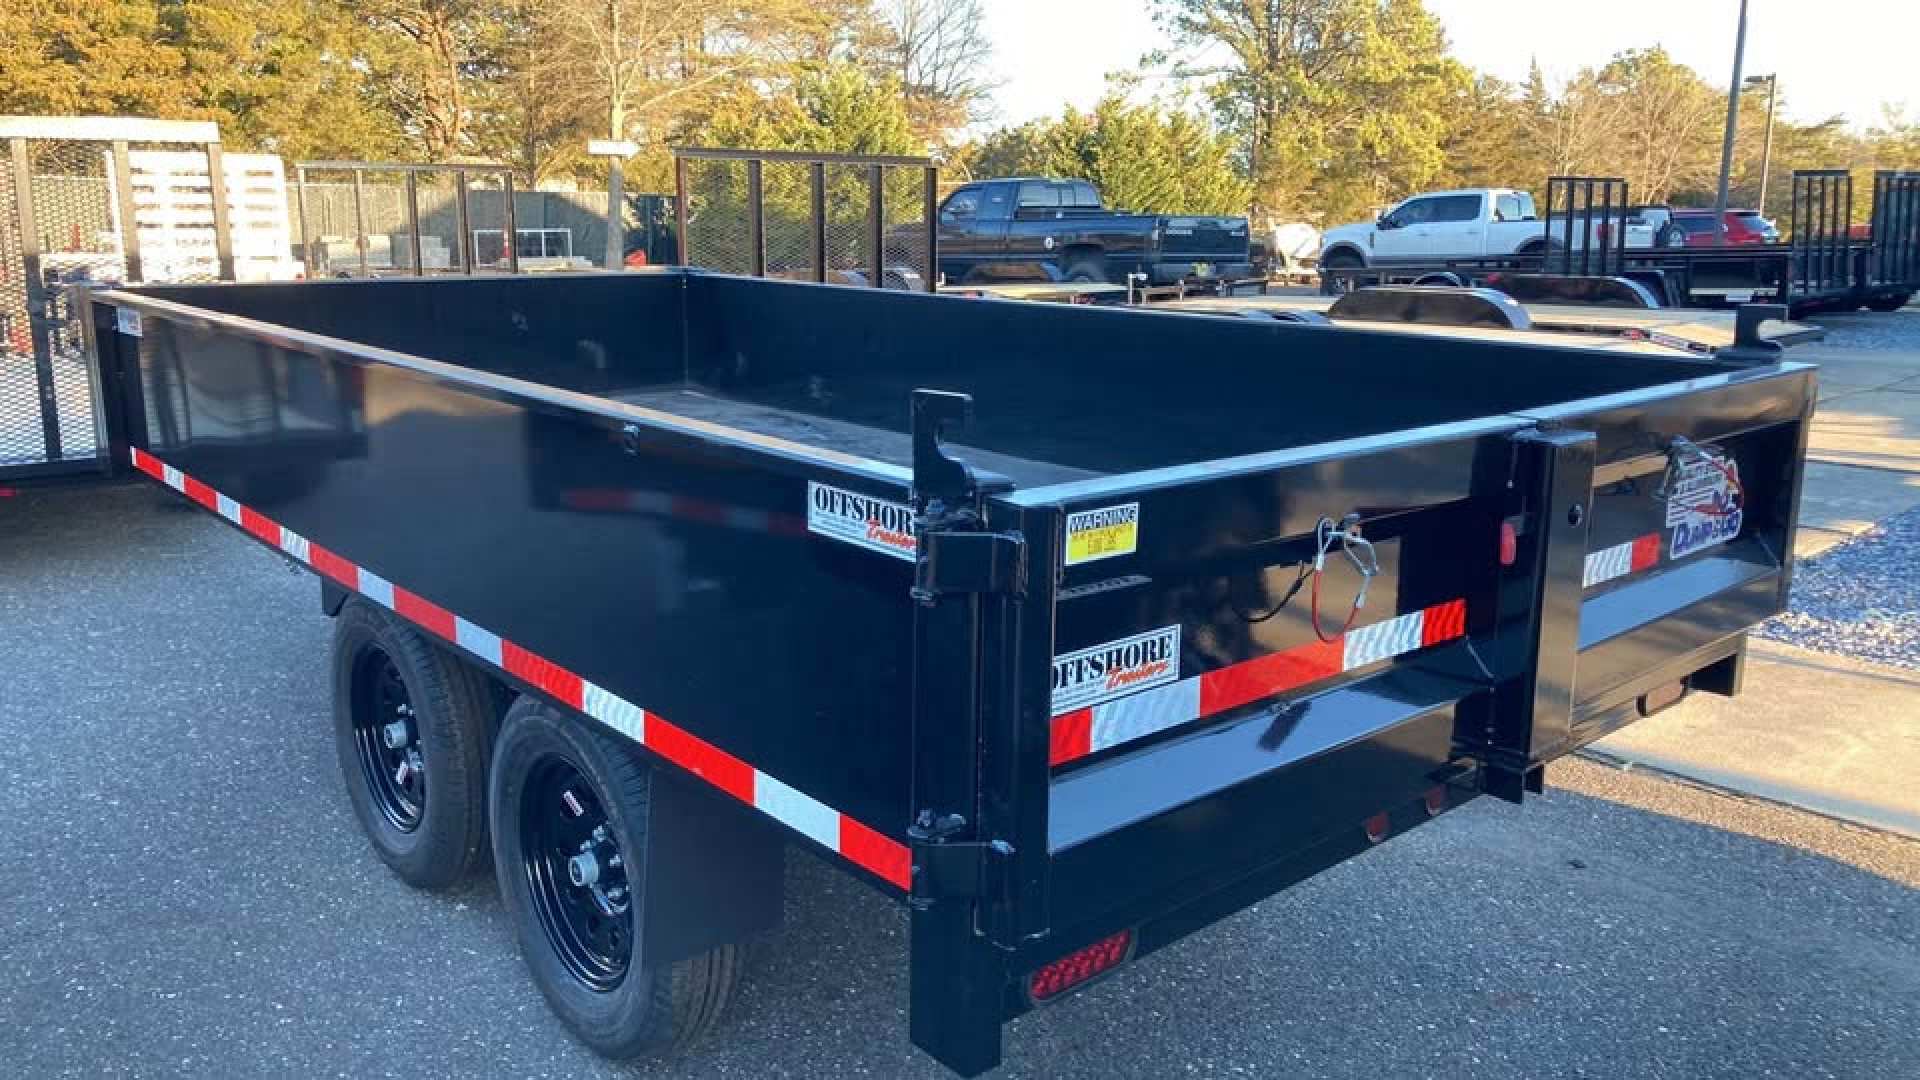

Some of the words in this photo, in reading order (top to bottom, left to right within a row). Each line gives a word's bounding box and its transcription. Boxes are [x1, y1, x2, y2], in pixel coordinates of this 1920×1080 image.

[815, 487, 913, 537] OFFSHOR
[1069, 505, 1138, 534] WARNING
[867, 519, 917, 549] Trailer
